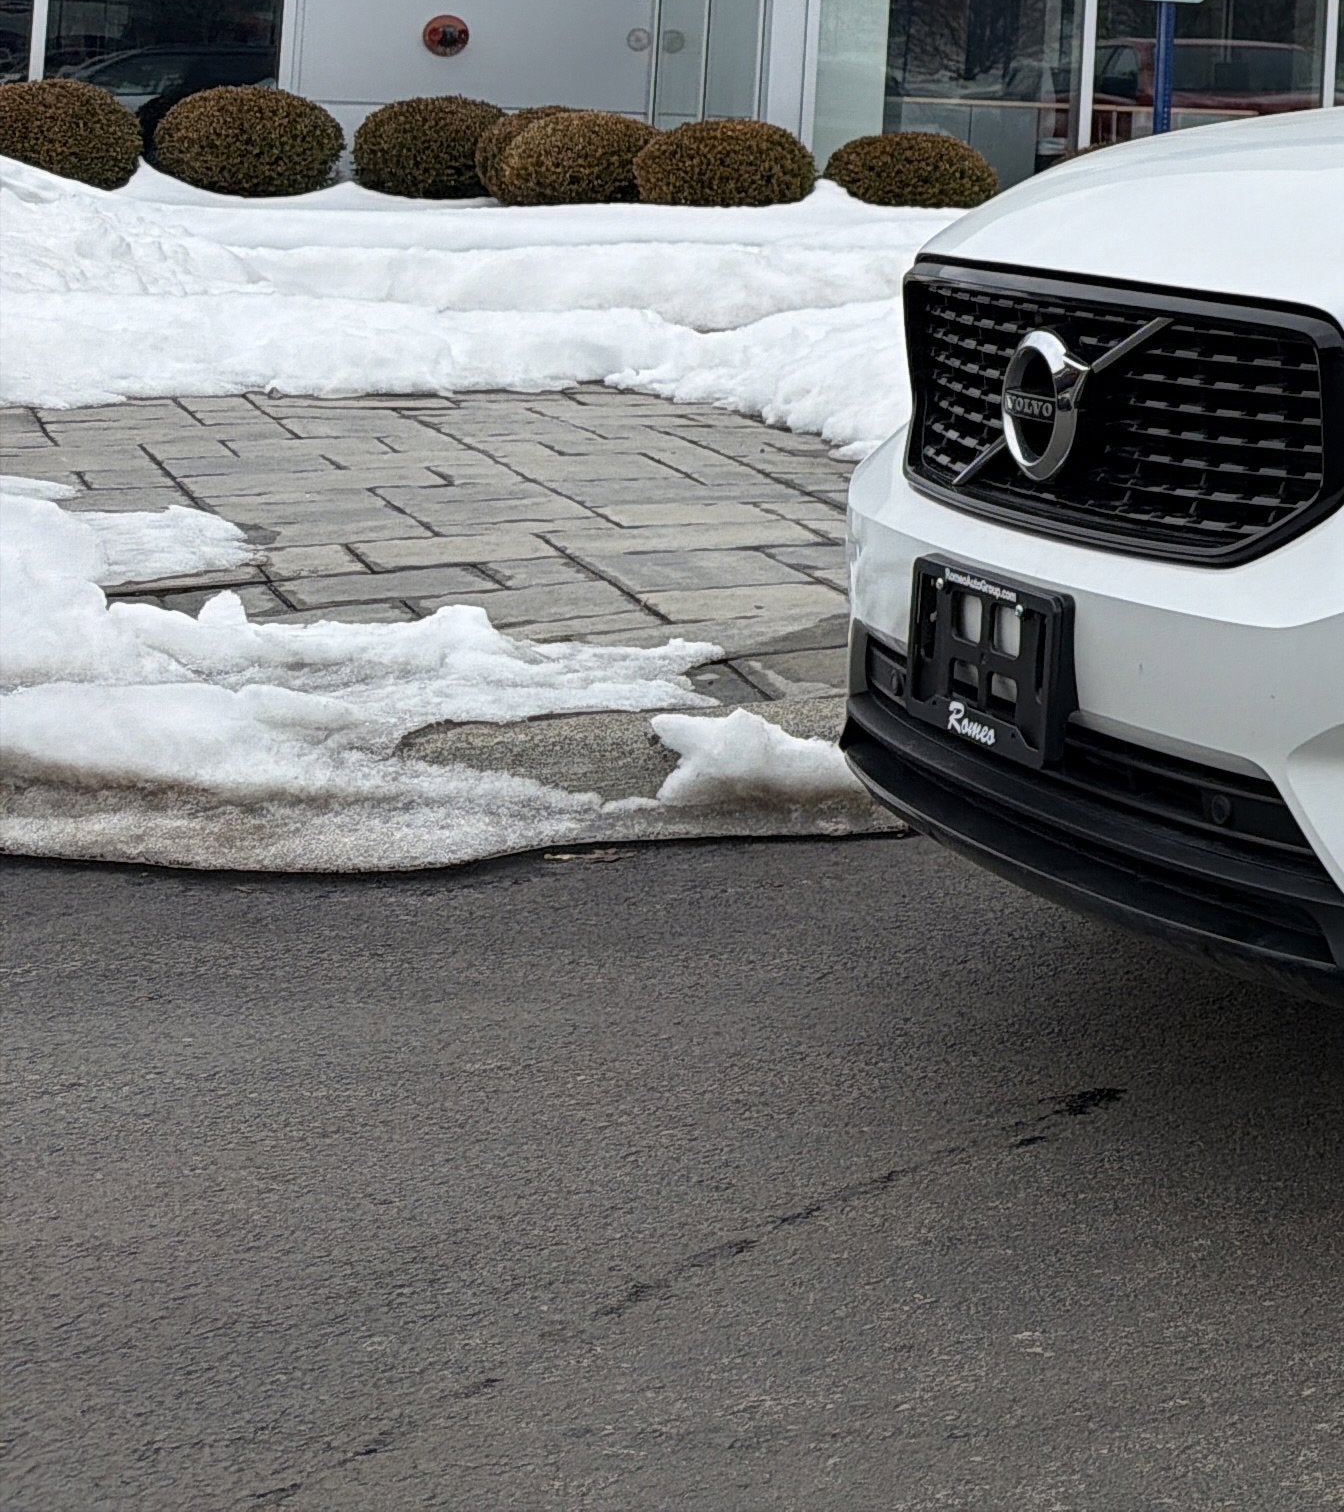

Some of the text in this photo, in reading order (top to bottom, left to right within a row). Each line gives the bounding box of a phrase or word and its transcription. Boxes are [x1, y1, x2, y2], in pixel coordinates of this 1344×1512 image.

[1005, 393, 1053, 417] VOLVO
[944, 567, 1017, 603] RomeoAutoGroup.com
[947, 701, 996, 746] Romeo
